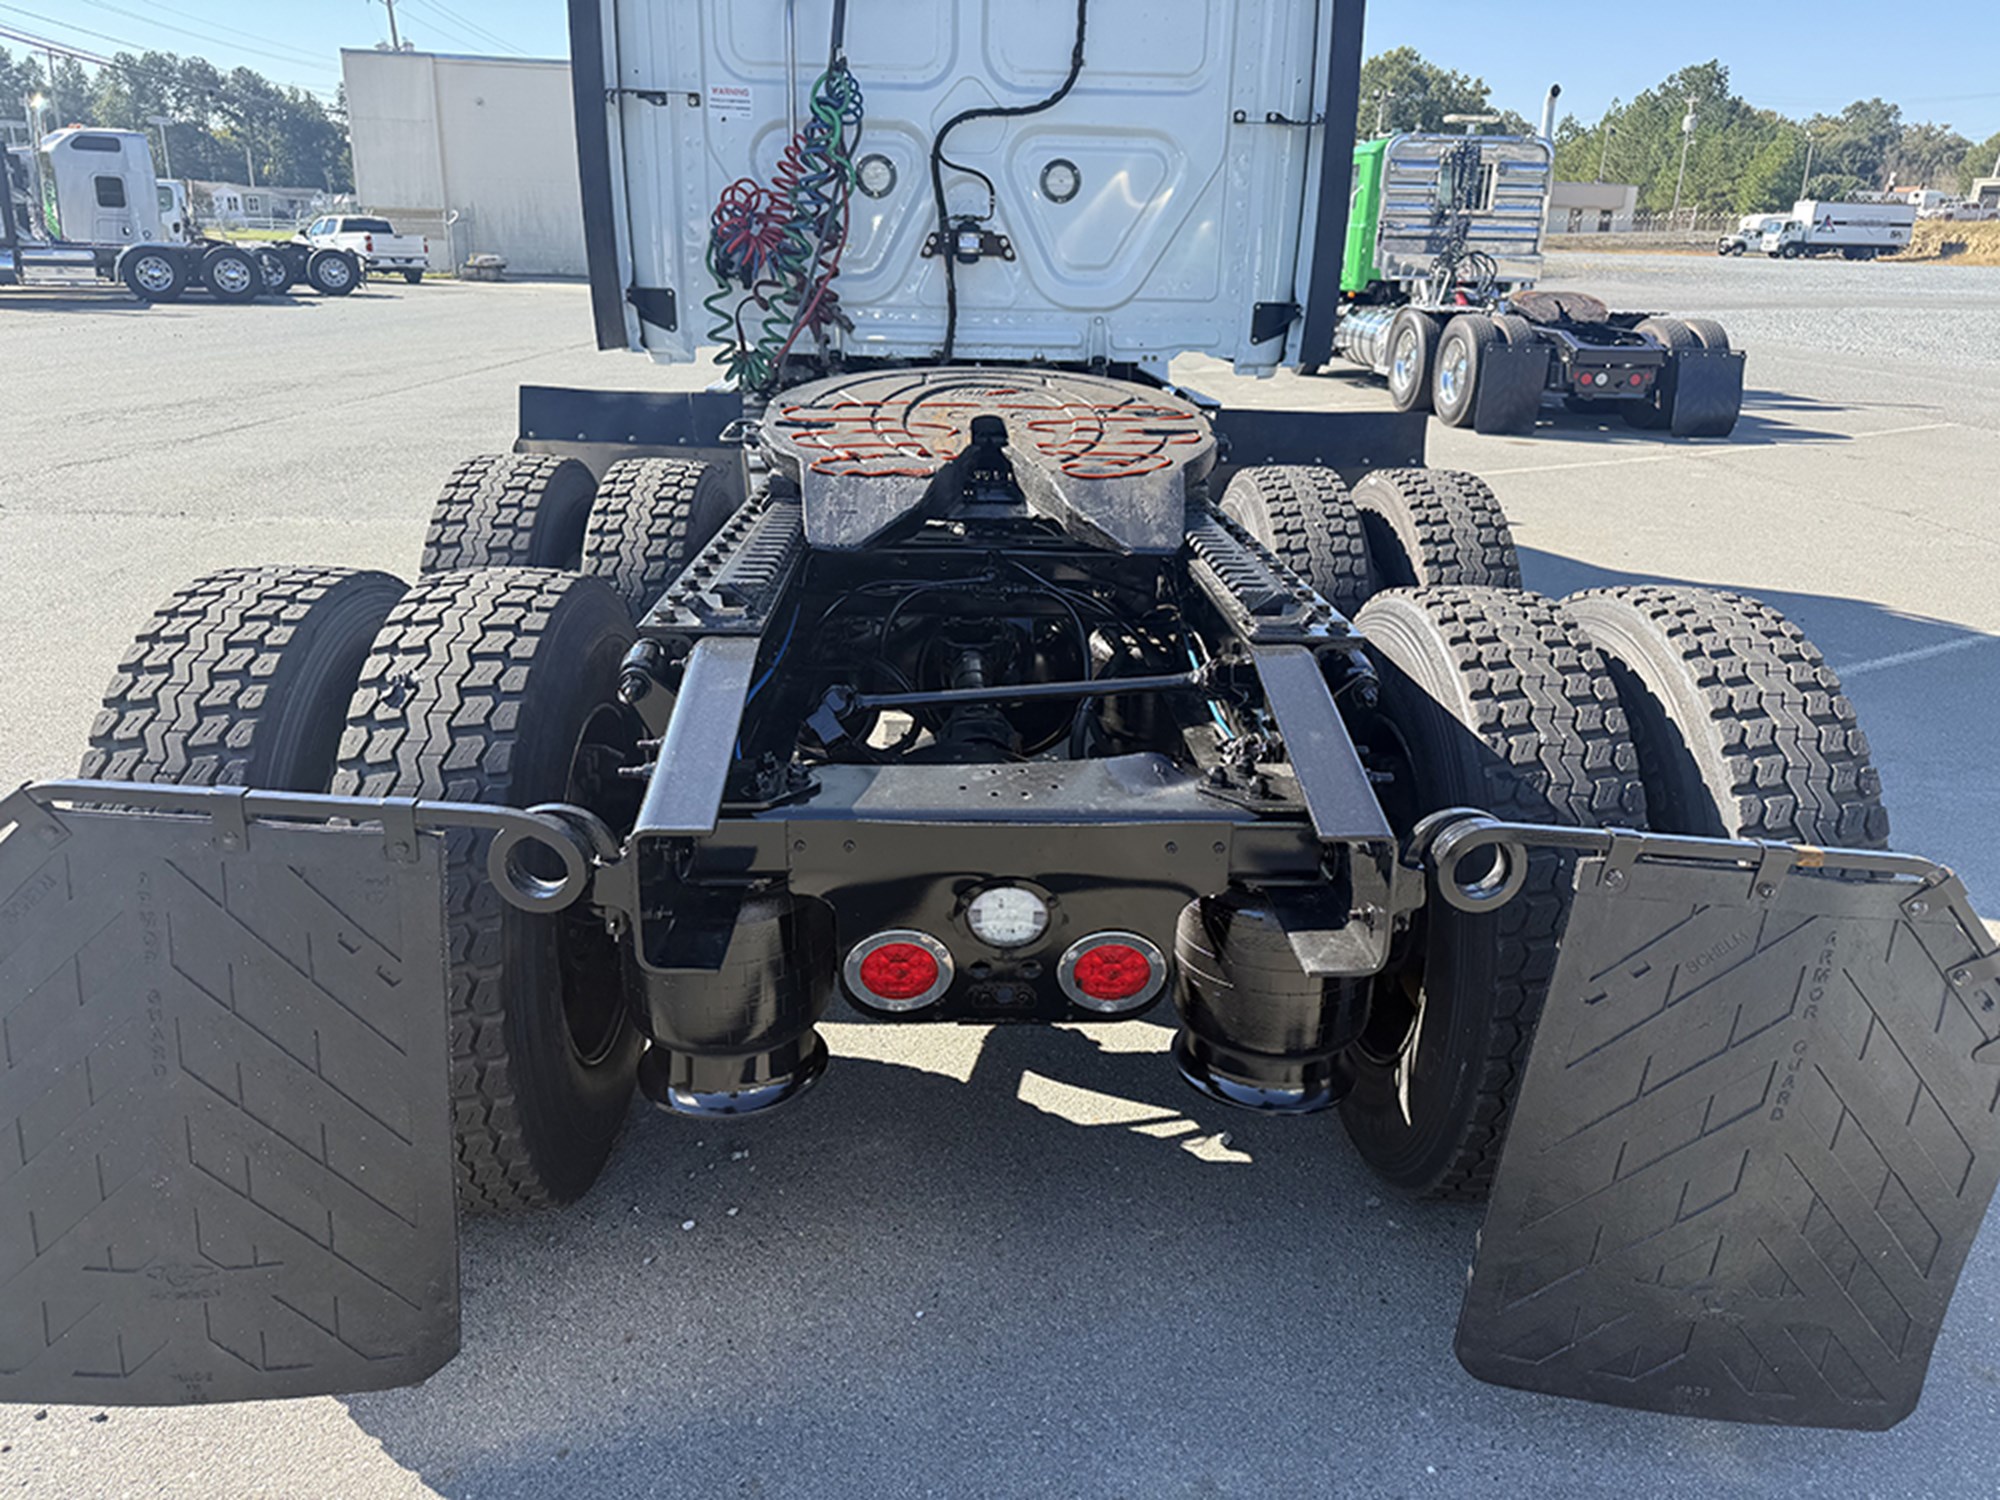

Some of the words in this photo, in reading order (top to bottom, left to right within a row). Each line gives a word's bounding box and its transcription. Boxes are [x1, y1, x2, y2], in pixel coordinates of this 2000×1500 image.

[711, 87, 750, 97] WARNING
[1802, 929, 1838, 1020] ARMOR
[1768, 1039, 1809, 1122] GUARD
